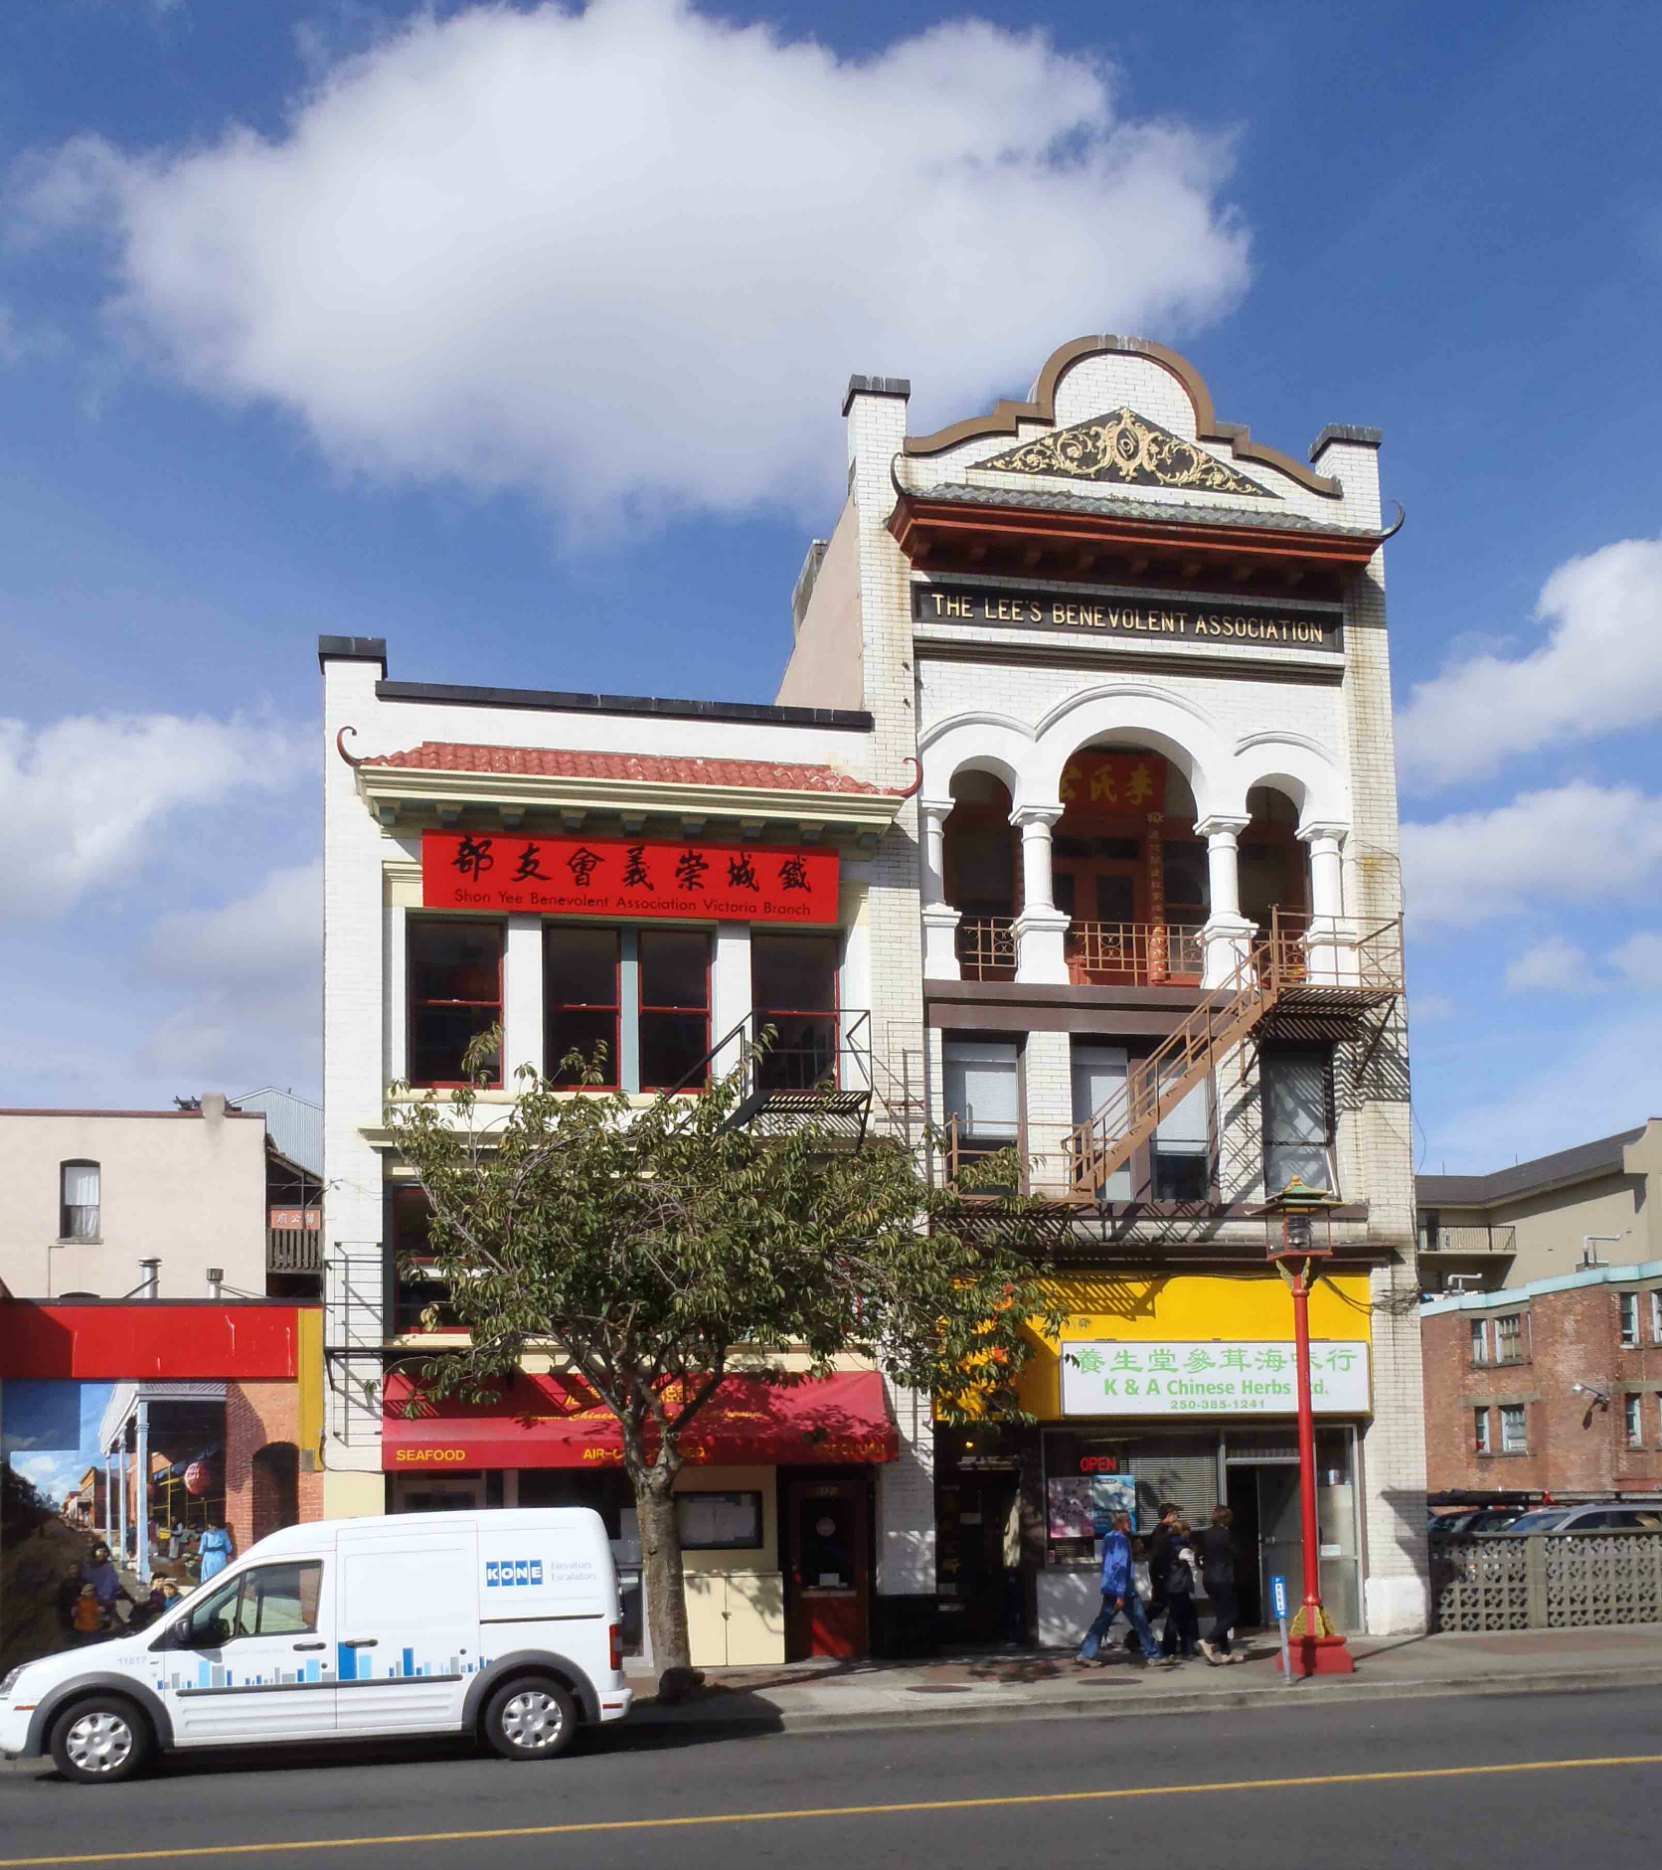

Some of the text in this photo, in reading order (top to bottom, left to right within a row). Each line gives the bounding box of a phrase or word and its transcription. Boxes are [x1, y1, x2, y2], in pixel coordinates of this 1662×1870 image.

[932, 593, 1323, 644] THE LEE'S BENEVOLENT ASSOCIATION
[454, 888, 811, 916] Shon Yee Benevolent Association Victoria Branch
[1104, 1379, 1118, 1396] K
[1125, 1379, 1139, 1396] &
[1146, 1379, 1161, 1396] A
[1167, 1379, 1236, 1396] Chinese
[1241, 1379, 1292, 1395] Herbs
[1170, 1399, 1265, 1411] 250-385-1241
[396, 1449, 466, 1461] SEAFOOD
[1079, 1456, 1117, 1472] OPEN
[487, 1564, 543, 1584] KONE
